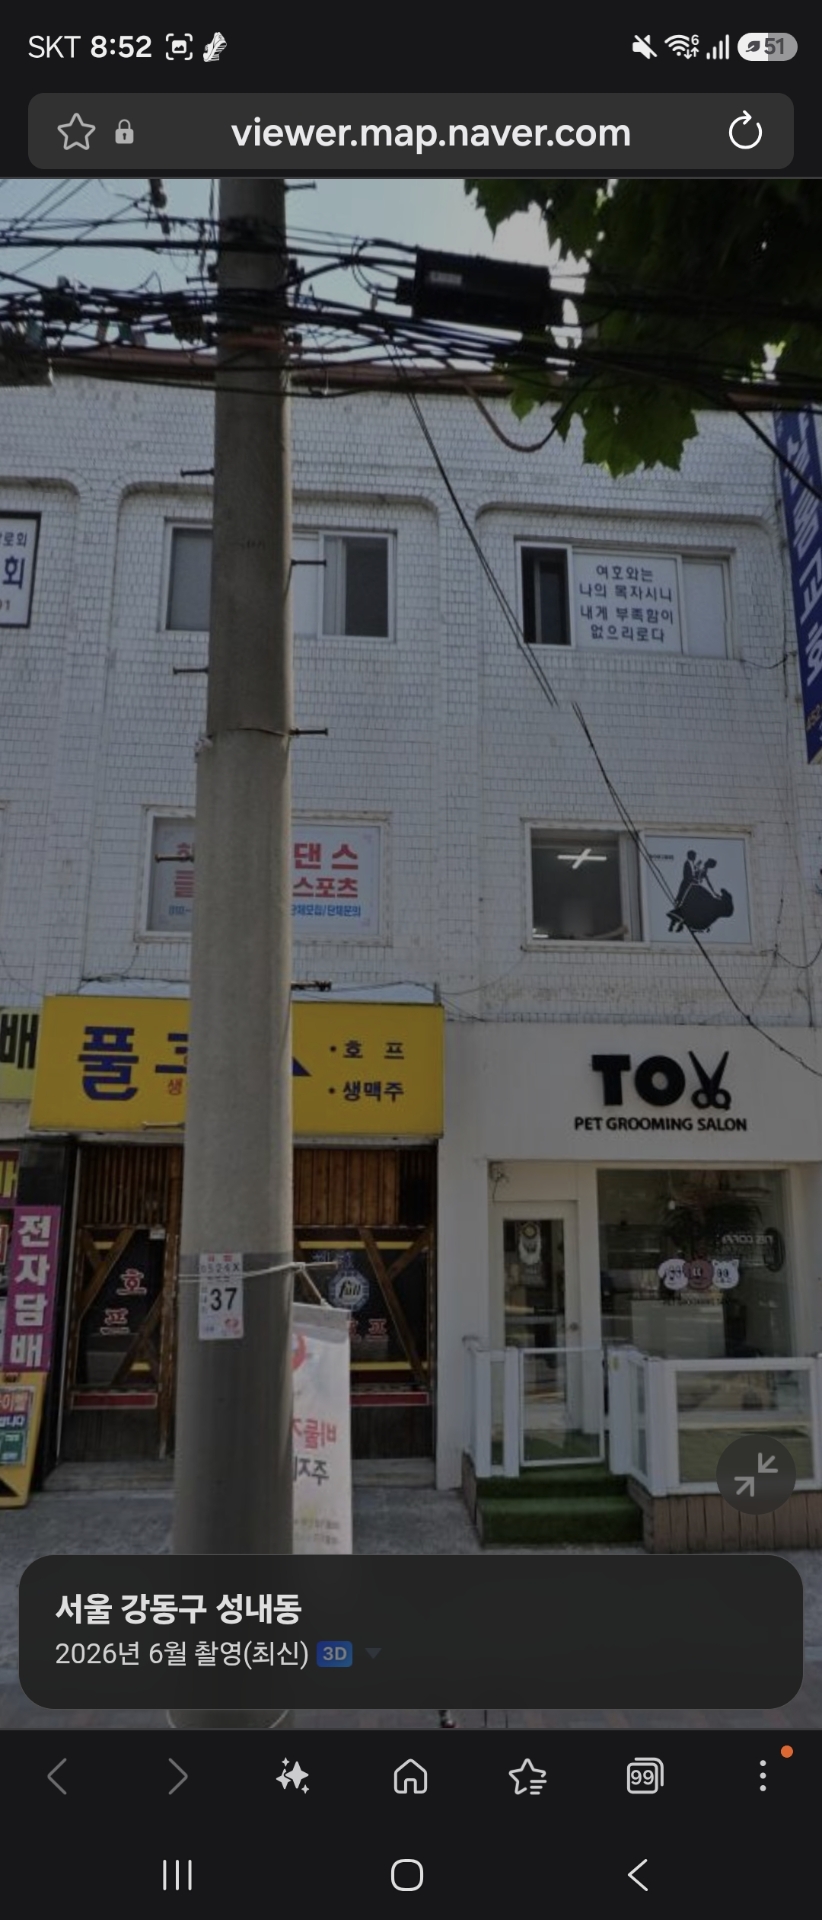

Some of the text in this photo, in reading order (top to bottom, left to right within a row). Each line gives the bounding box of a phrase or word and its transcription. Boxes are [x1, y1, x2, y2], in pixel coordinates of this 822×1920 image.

[596, 564, 653, 583] 여호와는
[579, 582, 672, 603] 나의 목자시니
[580, 604, 673, 626] 내게 부족함이
[590, 624, 664, 644] 없으리로다
[293, 877, 358, 898] 스포츠
[343, 1080, 404, 1103] 생맥주
[575, 1117, 747, 1131] PET GROOMING SALON
[9, 1214, 51, 1368] 전자담배
[210, 1287, 237, 1311] 37
